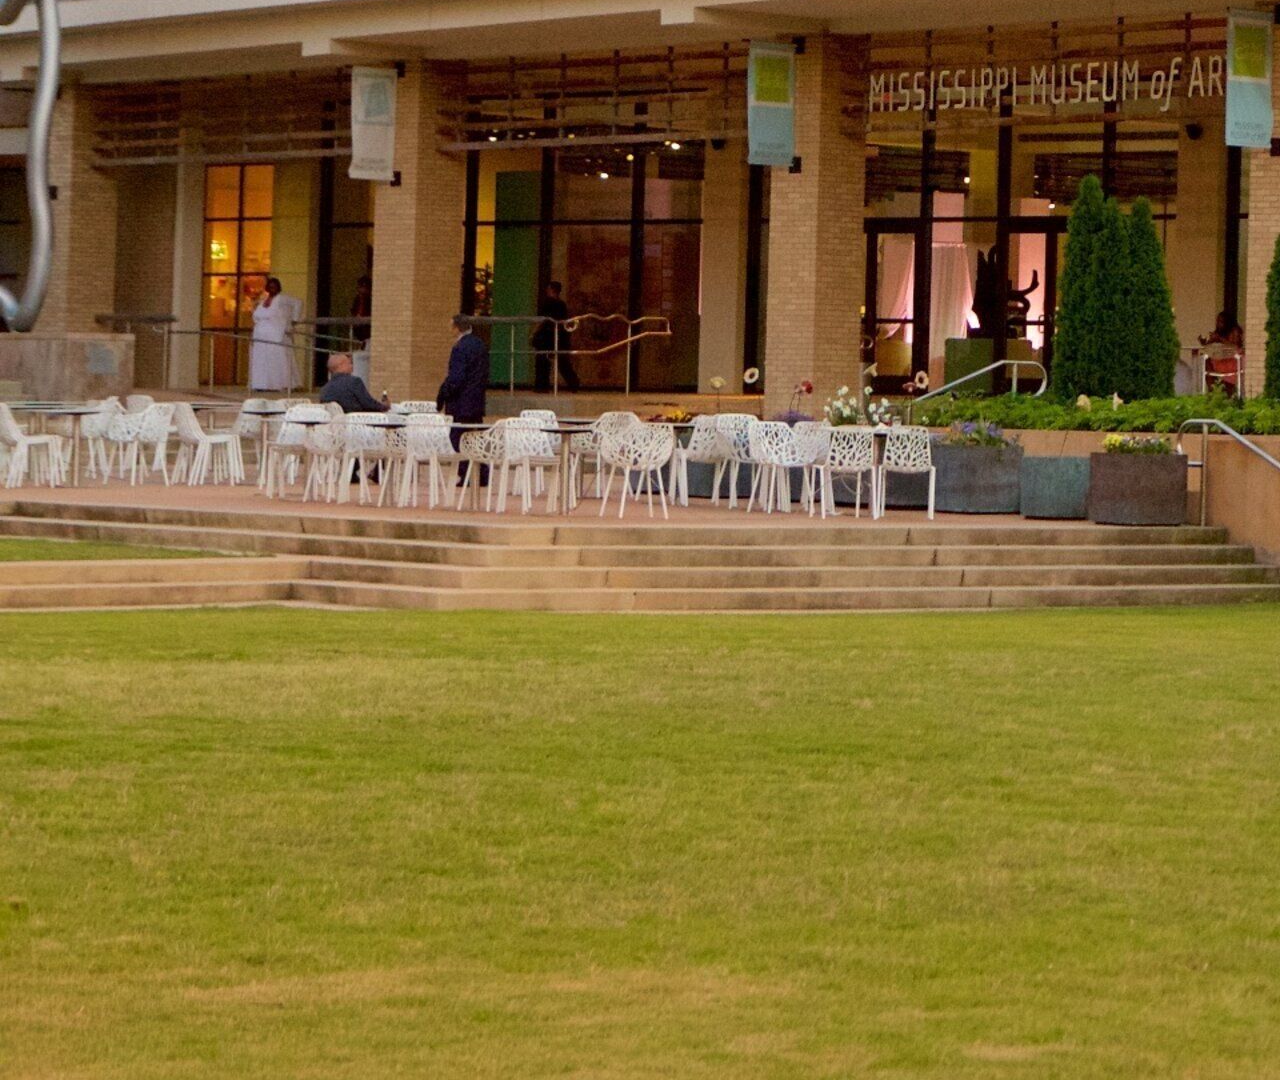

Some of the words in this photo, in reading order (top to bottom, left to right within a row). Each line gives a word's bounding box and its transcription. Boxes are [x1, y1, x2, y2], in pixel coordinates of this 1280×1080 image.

[868, 66, 1017, 112] MISSISSIPPI
[1030, 59, 1139, 106] MUSEUM
[1150, 56, 1182, 112] of
[1187, 55, 1224, 98] AR
